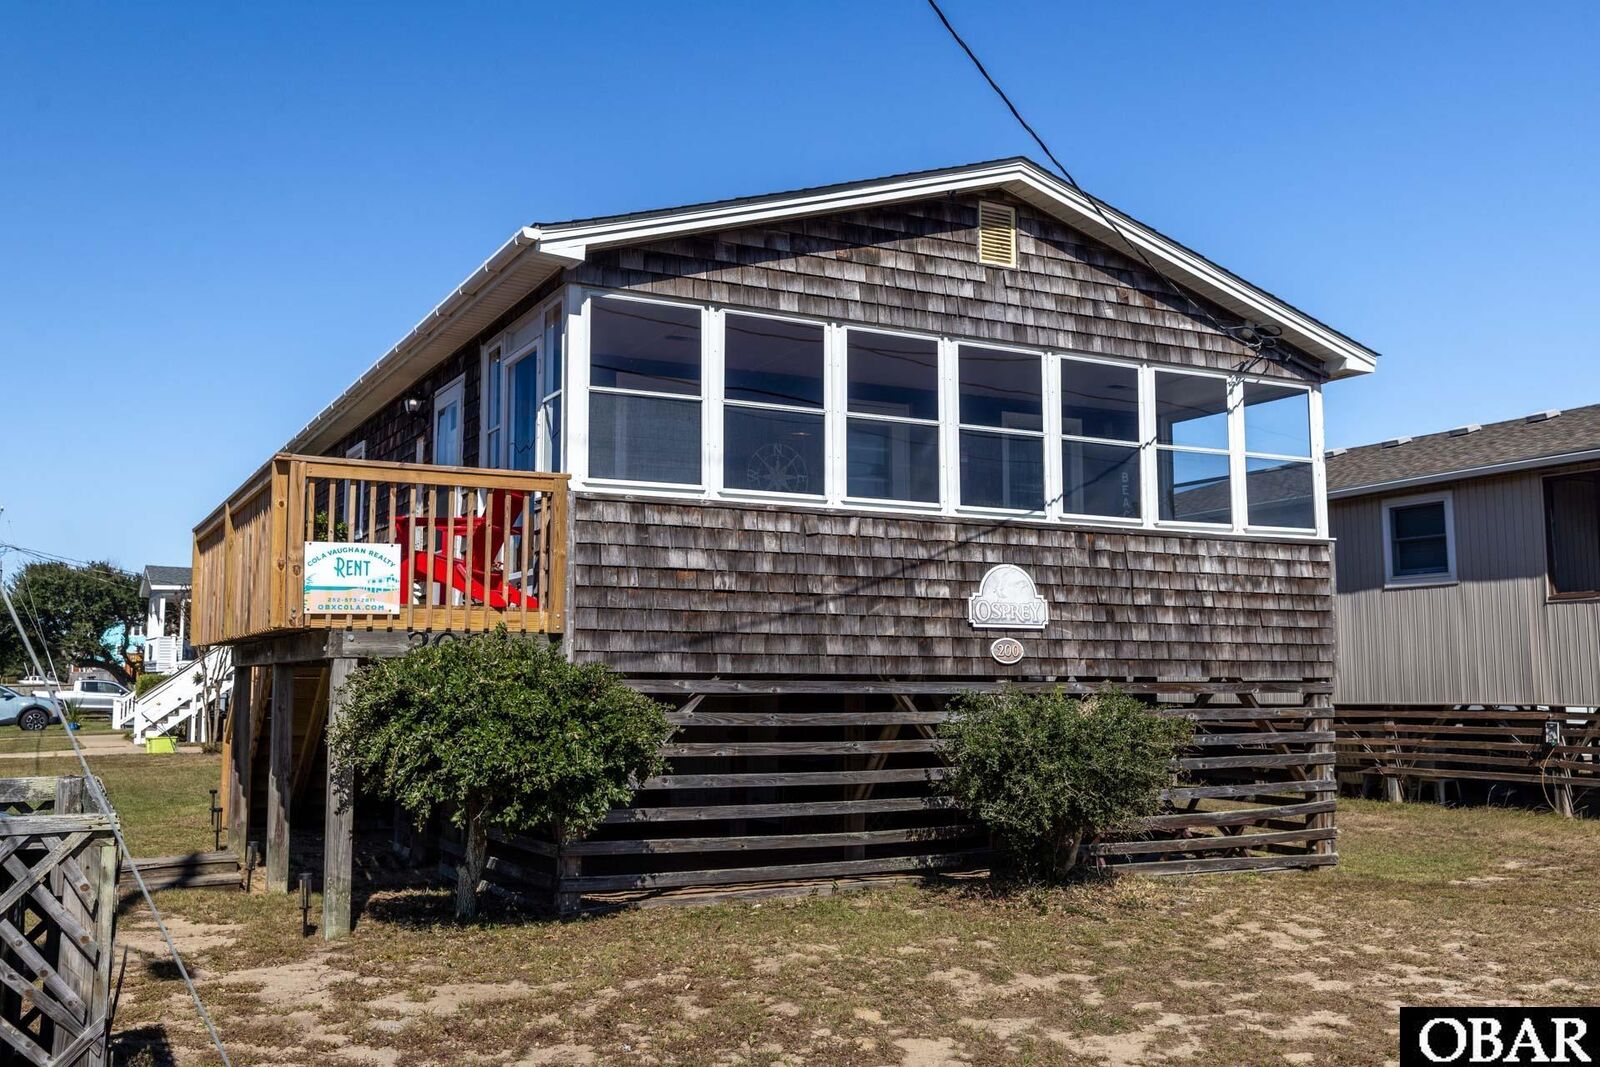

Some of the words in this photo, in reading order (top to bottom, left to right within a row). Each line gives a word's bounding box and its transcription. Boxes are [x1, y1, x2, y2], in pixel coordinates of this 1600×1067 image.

[307, 553, 327, 567] COLA
[327, 547, 367, 556] VAUGHAN
[368, 550, 396, 567] REALTY
[333, 557, 371, 578] RENT
[975, 600, 1041, 623] OSPREY
[997, 643, 1020, 657] 200
